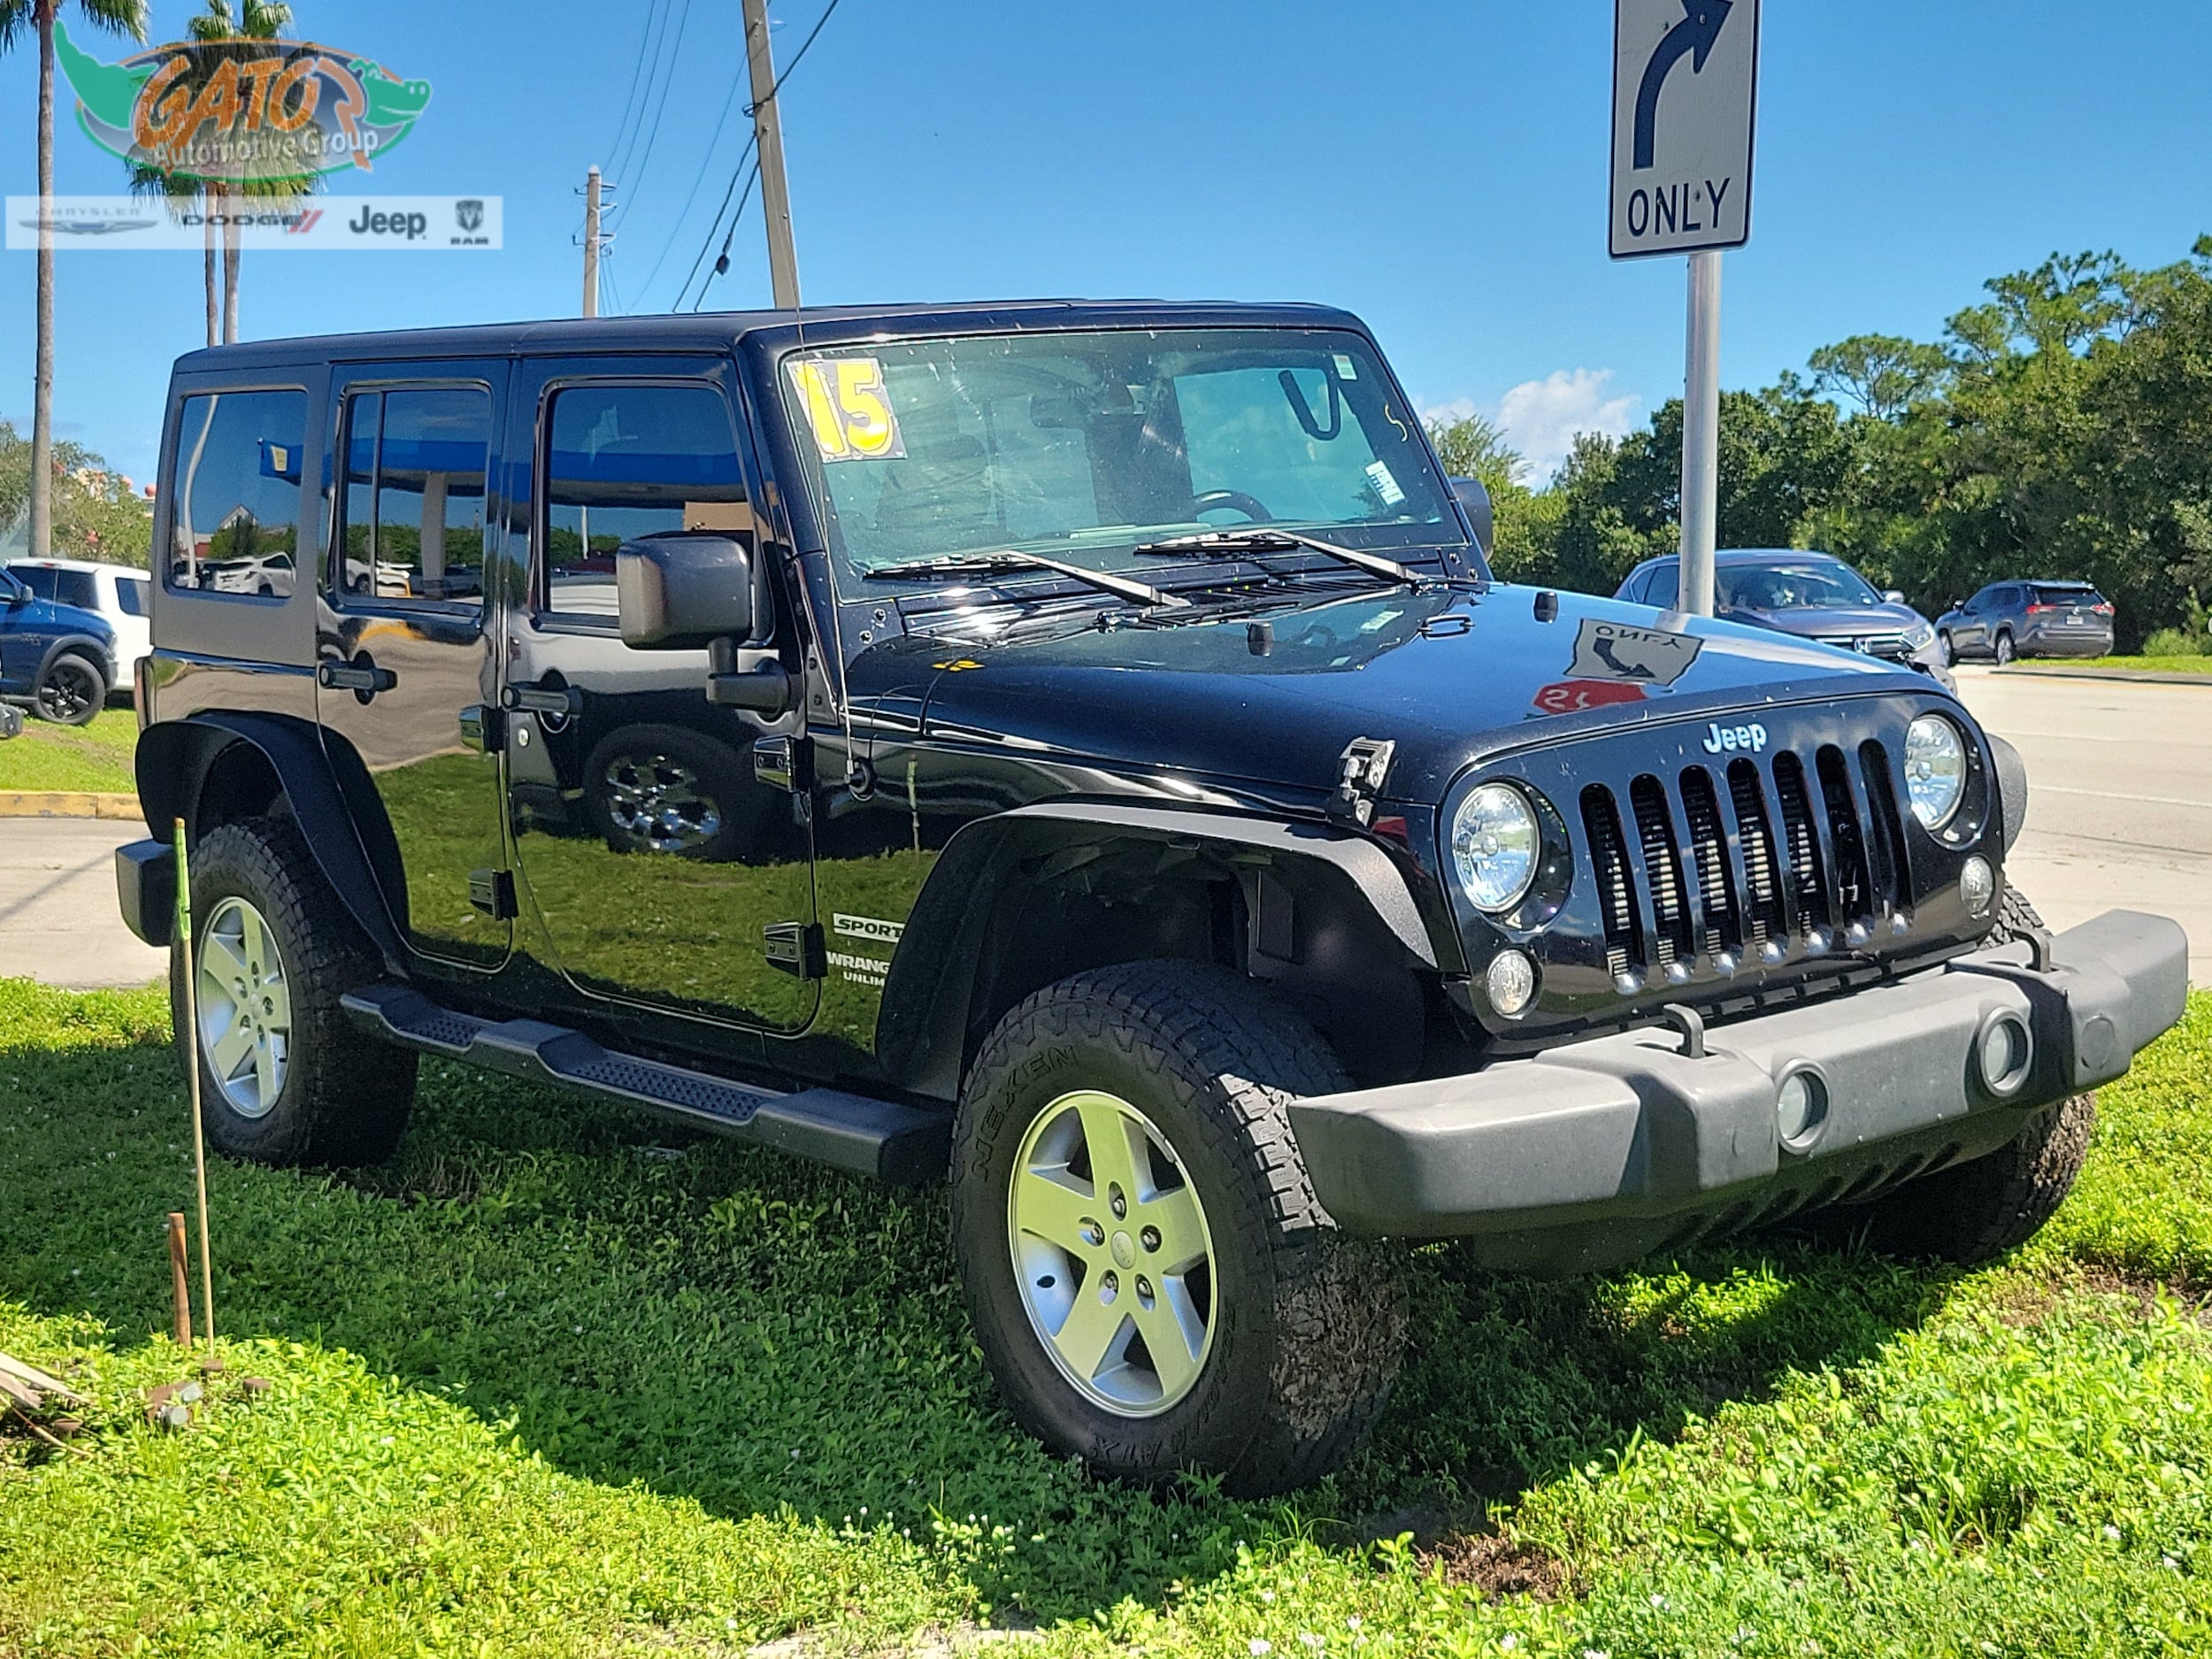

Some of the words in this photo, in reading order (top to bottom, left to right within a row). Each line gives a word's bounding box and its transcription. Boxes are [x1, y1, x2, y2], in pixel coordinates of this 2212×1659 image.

[1628, 177, 1731, 237] ONLY
[795, 362, 894, 457] 15
[1702, 723, 1767, 753] Jeep
[838, 918, 902, 938] SPORT
[972, 1045, 1079, 1182] NEXEN
